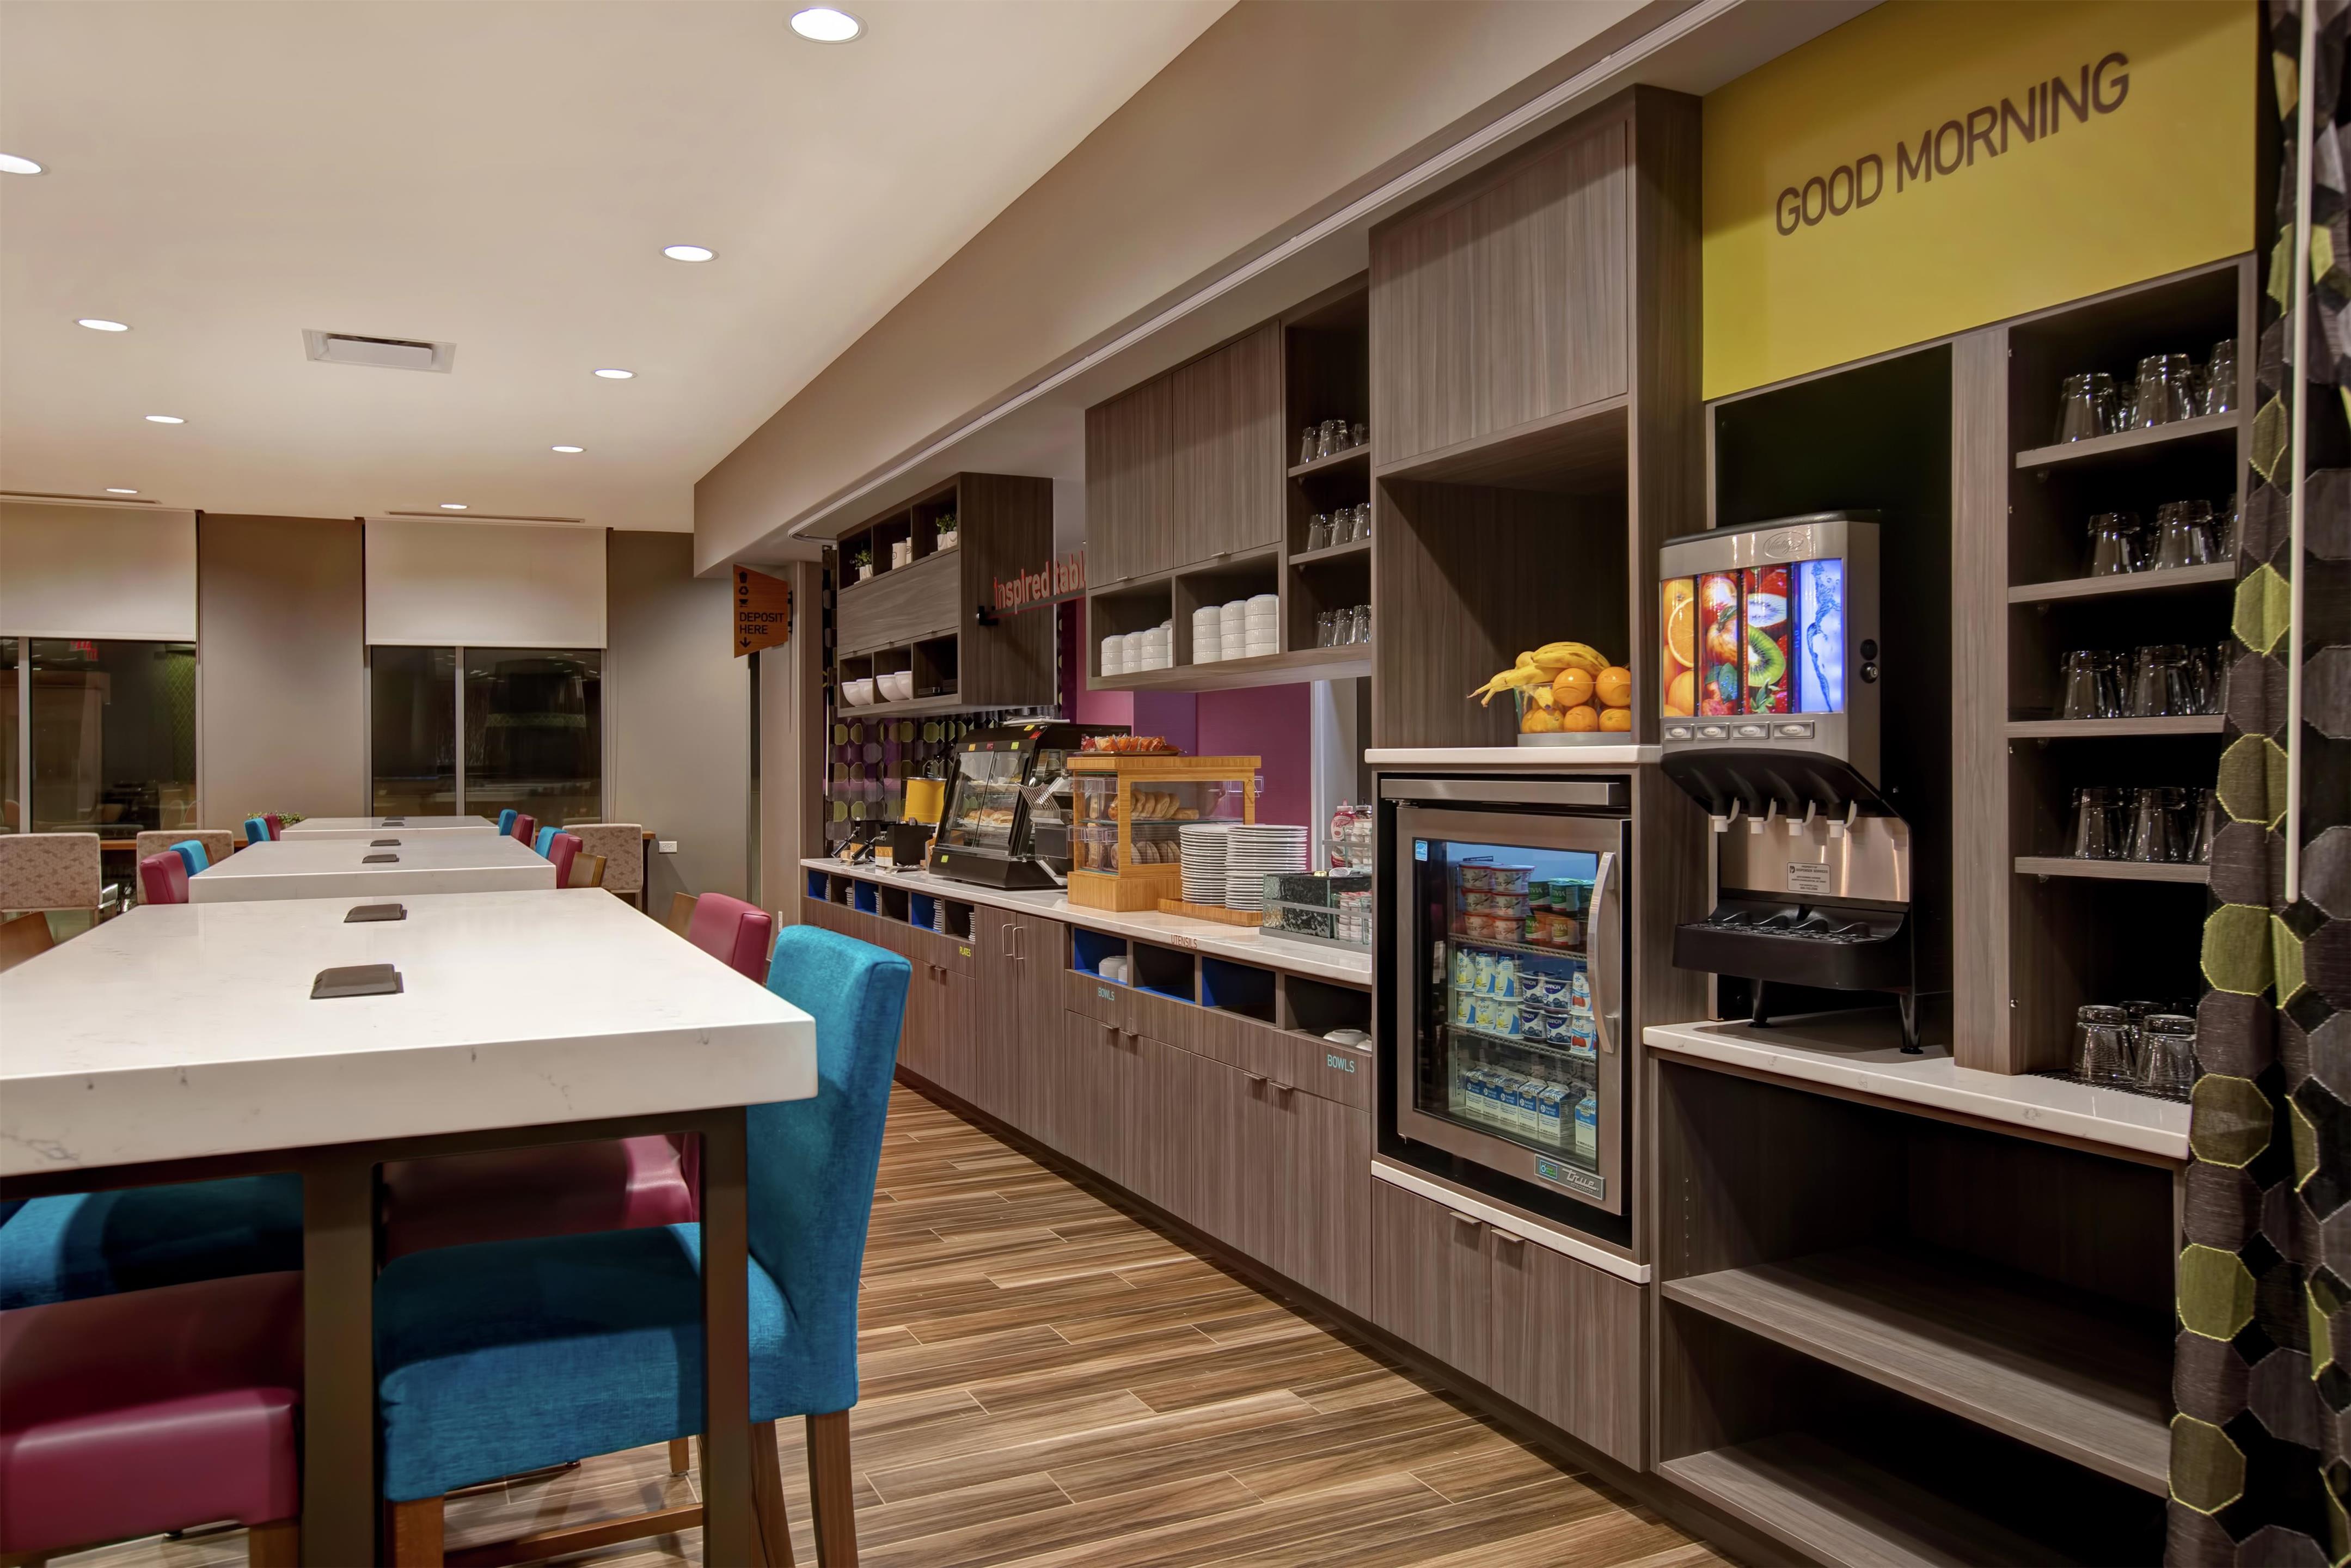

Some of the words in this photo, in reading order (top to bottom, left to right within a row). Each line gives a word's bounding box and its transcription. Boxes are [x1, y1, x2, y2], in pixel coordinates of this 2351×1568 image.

[1776, 154, 1883, 236] GOOD
[1897, 52, 2129, 193] MORNING
[994, 560, 1050, 614] inspired
[1055, 550, 1086, 595] tabl
[739, 612, 785, 623] DEPOSIT
[739, 624, 768, 634] HERE
[1171, 934, 1198, 948] UTENSILS
[959, 946, 971, 957] PLATES
[1098, 987, 1115, 1001] BOWLS
[1327, 1054, 1355, 1073] BOWLS
